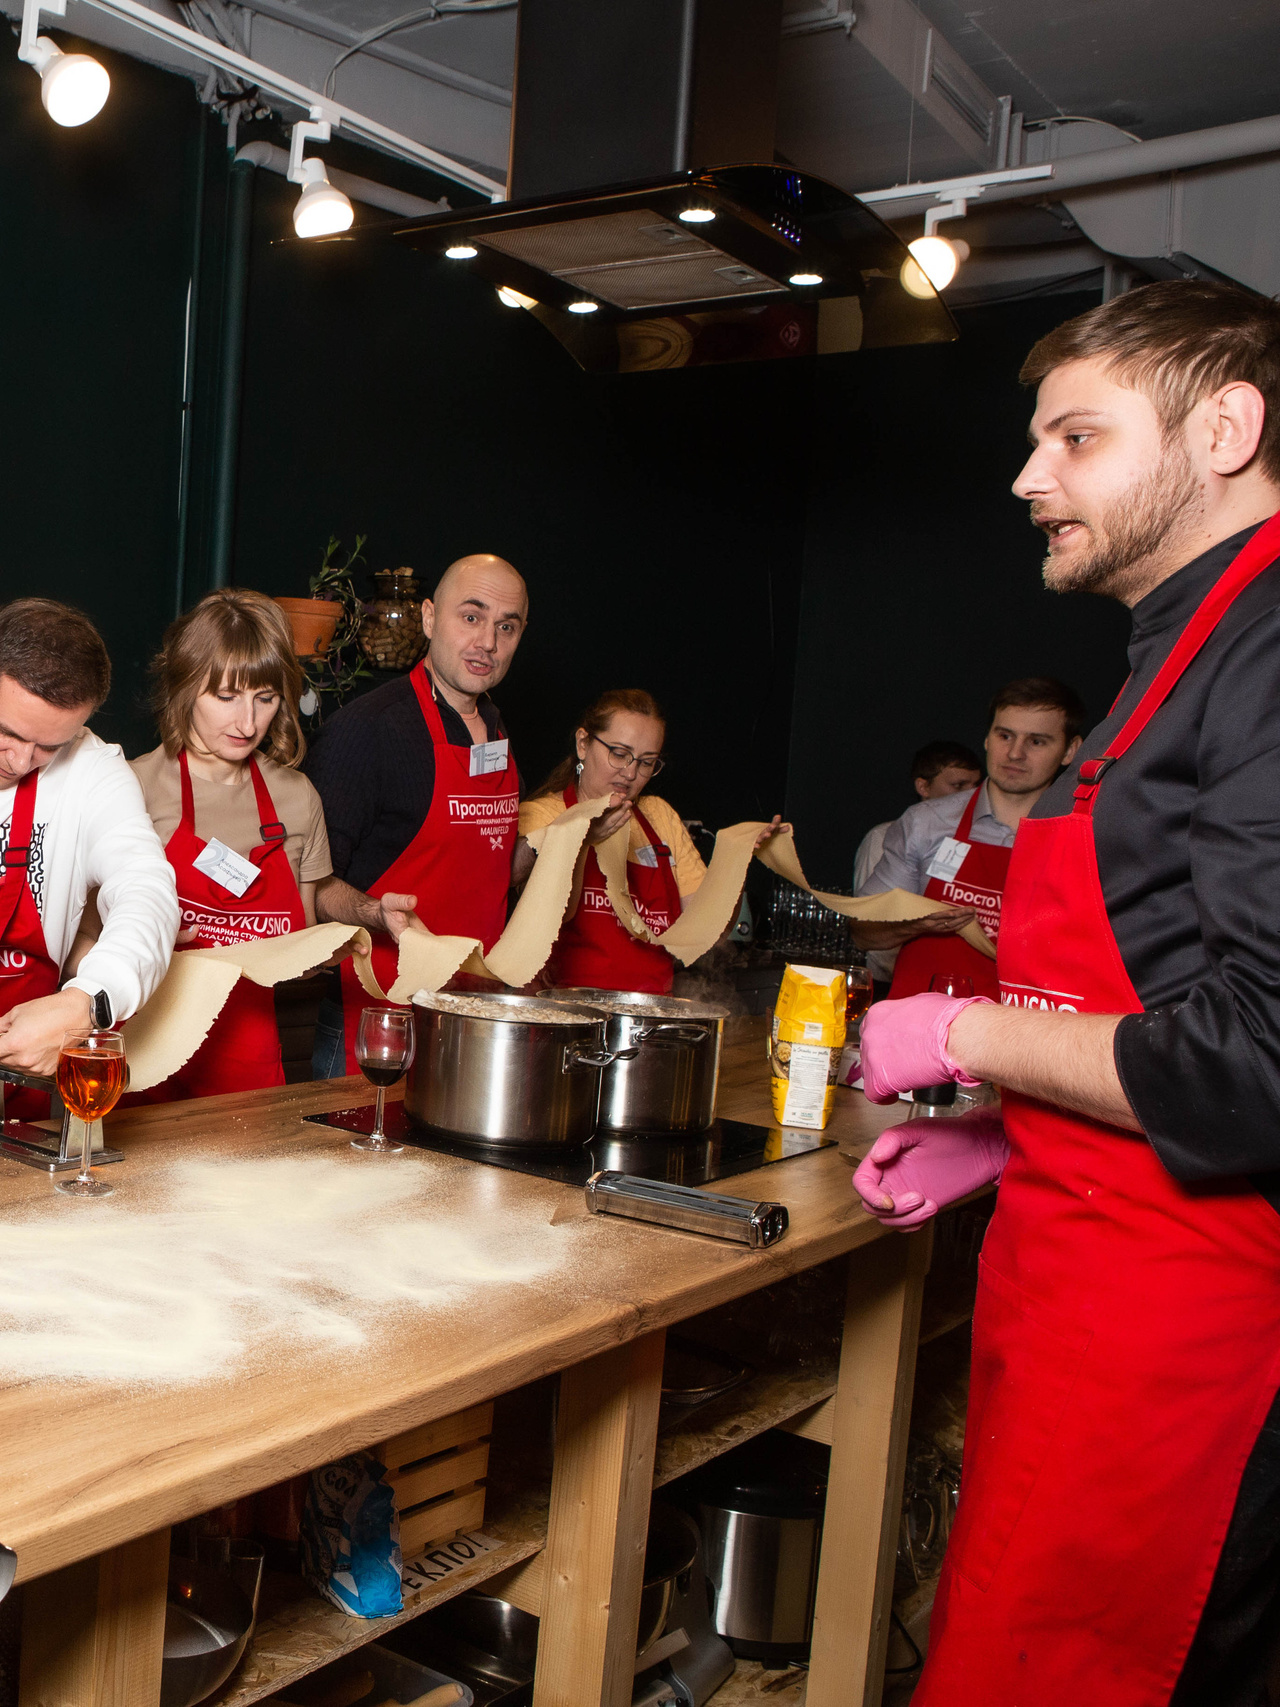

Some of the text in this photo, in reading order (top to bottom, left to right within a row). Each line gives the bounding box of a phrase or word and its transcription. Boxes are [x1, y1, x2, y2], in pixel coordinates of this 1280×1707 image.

[448, 796, 519, 820] ПростоVKUSN
[480, 825, 510, 836] MAUNFELD
[179, 907, 292, 936] остоVKUSNO
[198, 924, 240, 937] ЛИНАРНАЯ
[401, 1534, 490, 1597] ЕКЛО!
